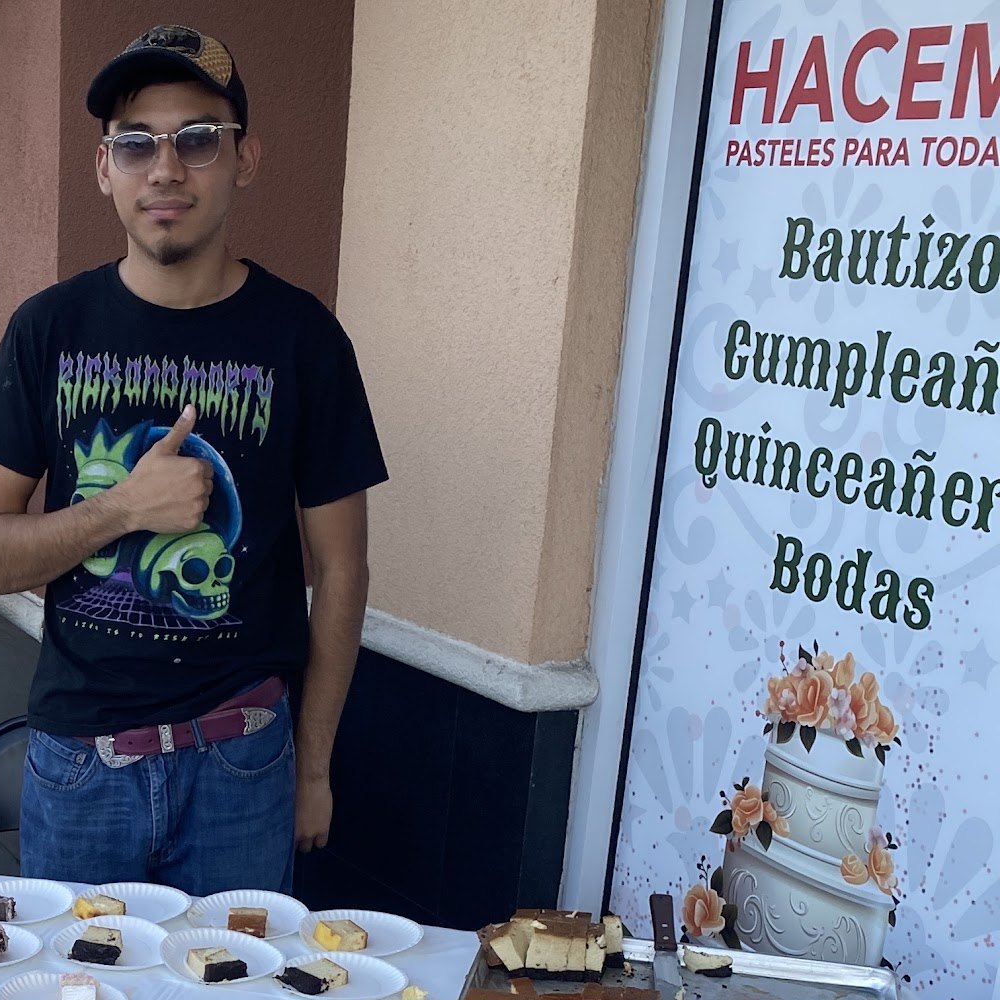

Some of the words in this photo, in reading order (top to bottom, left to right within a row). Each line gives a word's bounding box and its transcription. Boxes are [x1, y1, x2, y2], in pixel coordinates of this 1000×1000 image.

[729, 23, 1000, 124] HACEM
[725, 138, 837, 167] PASTELES
[842, 137, 910, 167] PARA
[920, 135, 1000, 167] TODA
[778, 214, 1000, 294] Bautizo
[723, 319, 1000, 415] Cumpleañ
[694, 417, 1000, 533] Quinceañer
[769, 533, 935, 630] Bodas
